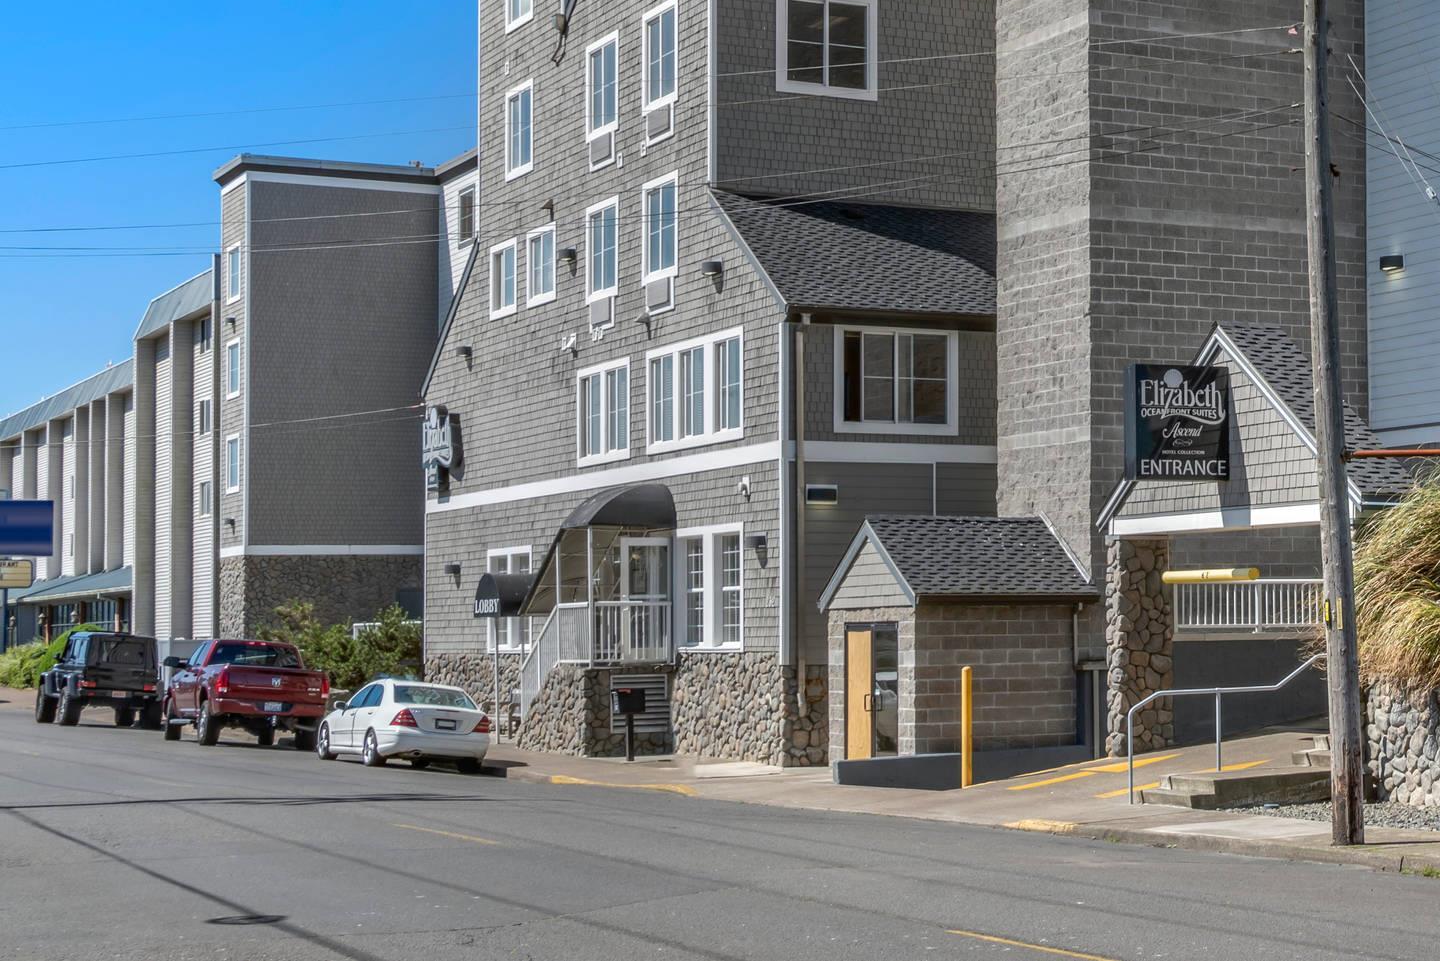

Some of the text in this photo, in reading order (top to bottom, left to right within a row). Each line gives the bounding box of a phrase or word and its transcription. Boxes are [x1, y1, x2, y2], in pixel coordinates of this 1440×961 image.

[1140, 379, 1226, 420] Elizabeth
[1141, 407, 1217, 419] OCEANFRONT SUITES
[1162, 421, 1203, 439] Ascend
[1140, 459, 1227, 476] ENTRANCE
[474, 598, 500, 614] LOBBY
